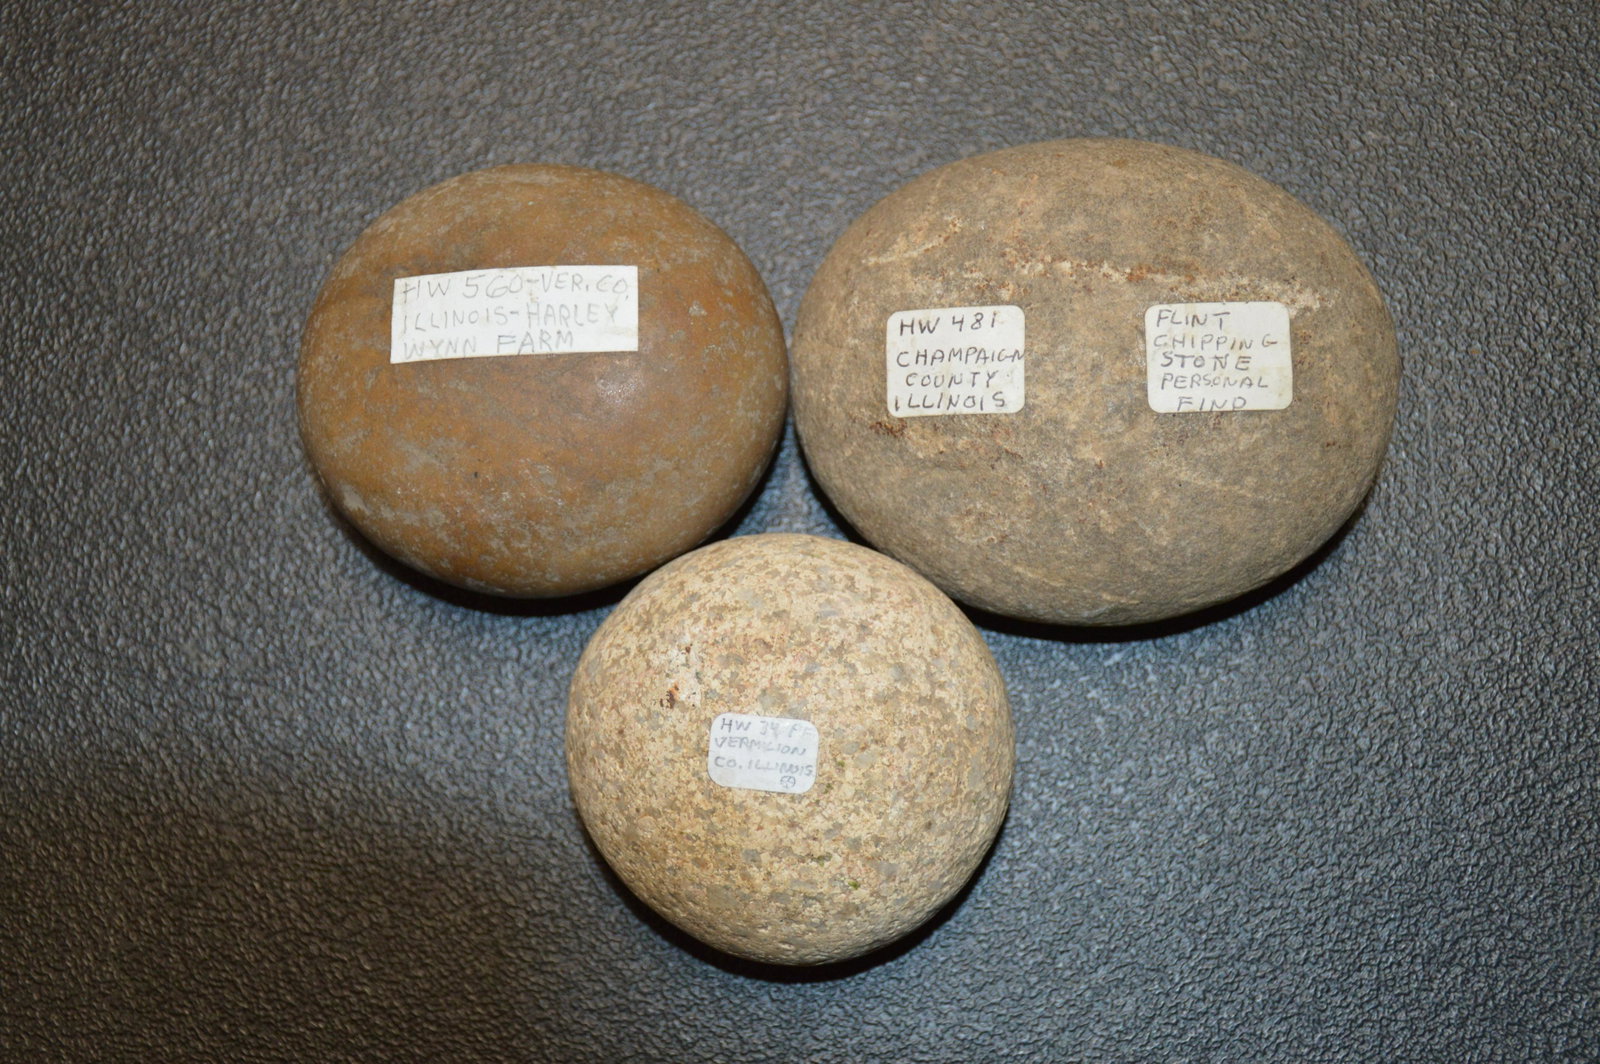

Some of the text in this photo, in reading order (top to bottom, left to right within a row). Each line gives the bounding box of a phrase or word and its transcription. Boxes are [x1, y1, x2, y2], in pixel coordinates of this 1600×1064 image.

[403, 279, 451, 304] HW
[899, 310, 998, 336] HW 481
[1156, 309, 1231, 330] FLINT
[403, 329, 574, 360] WYNN FARM
[1153, 333, 1278, 351] CHIPPING
[896, 346, 1025, 367] CHAMPAIGN
[1160, 351, 1252, 371] STONE
[905, 370, 999, 388] COUNTY
[1160, 372, 1268, 390] PERSONAL
[894, 391, 1006, 412] ILLINOIS
[720, 717, 751, 733] HW
